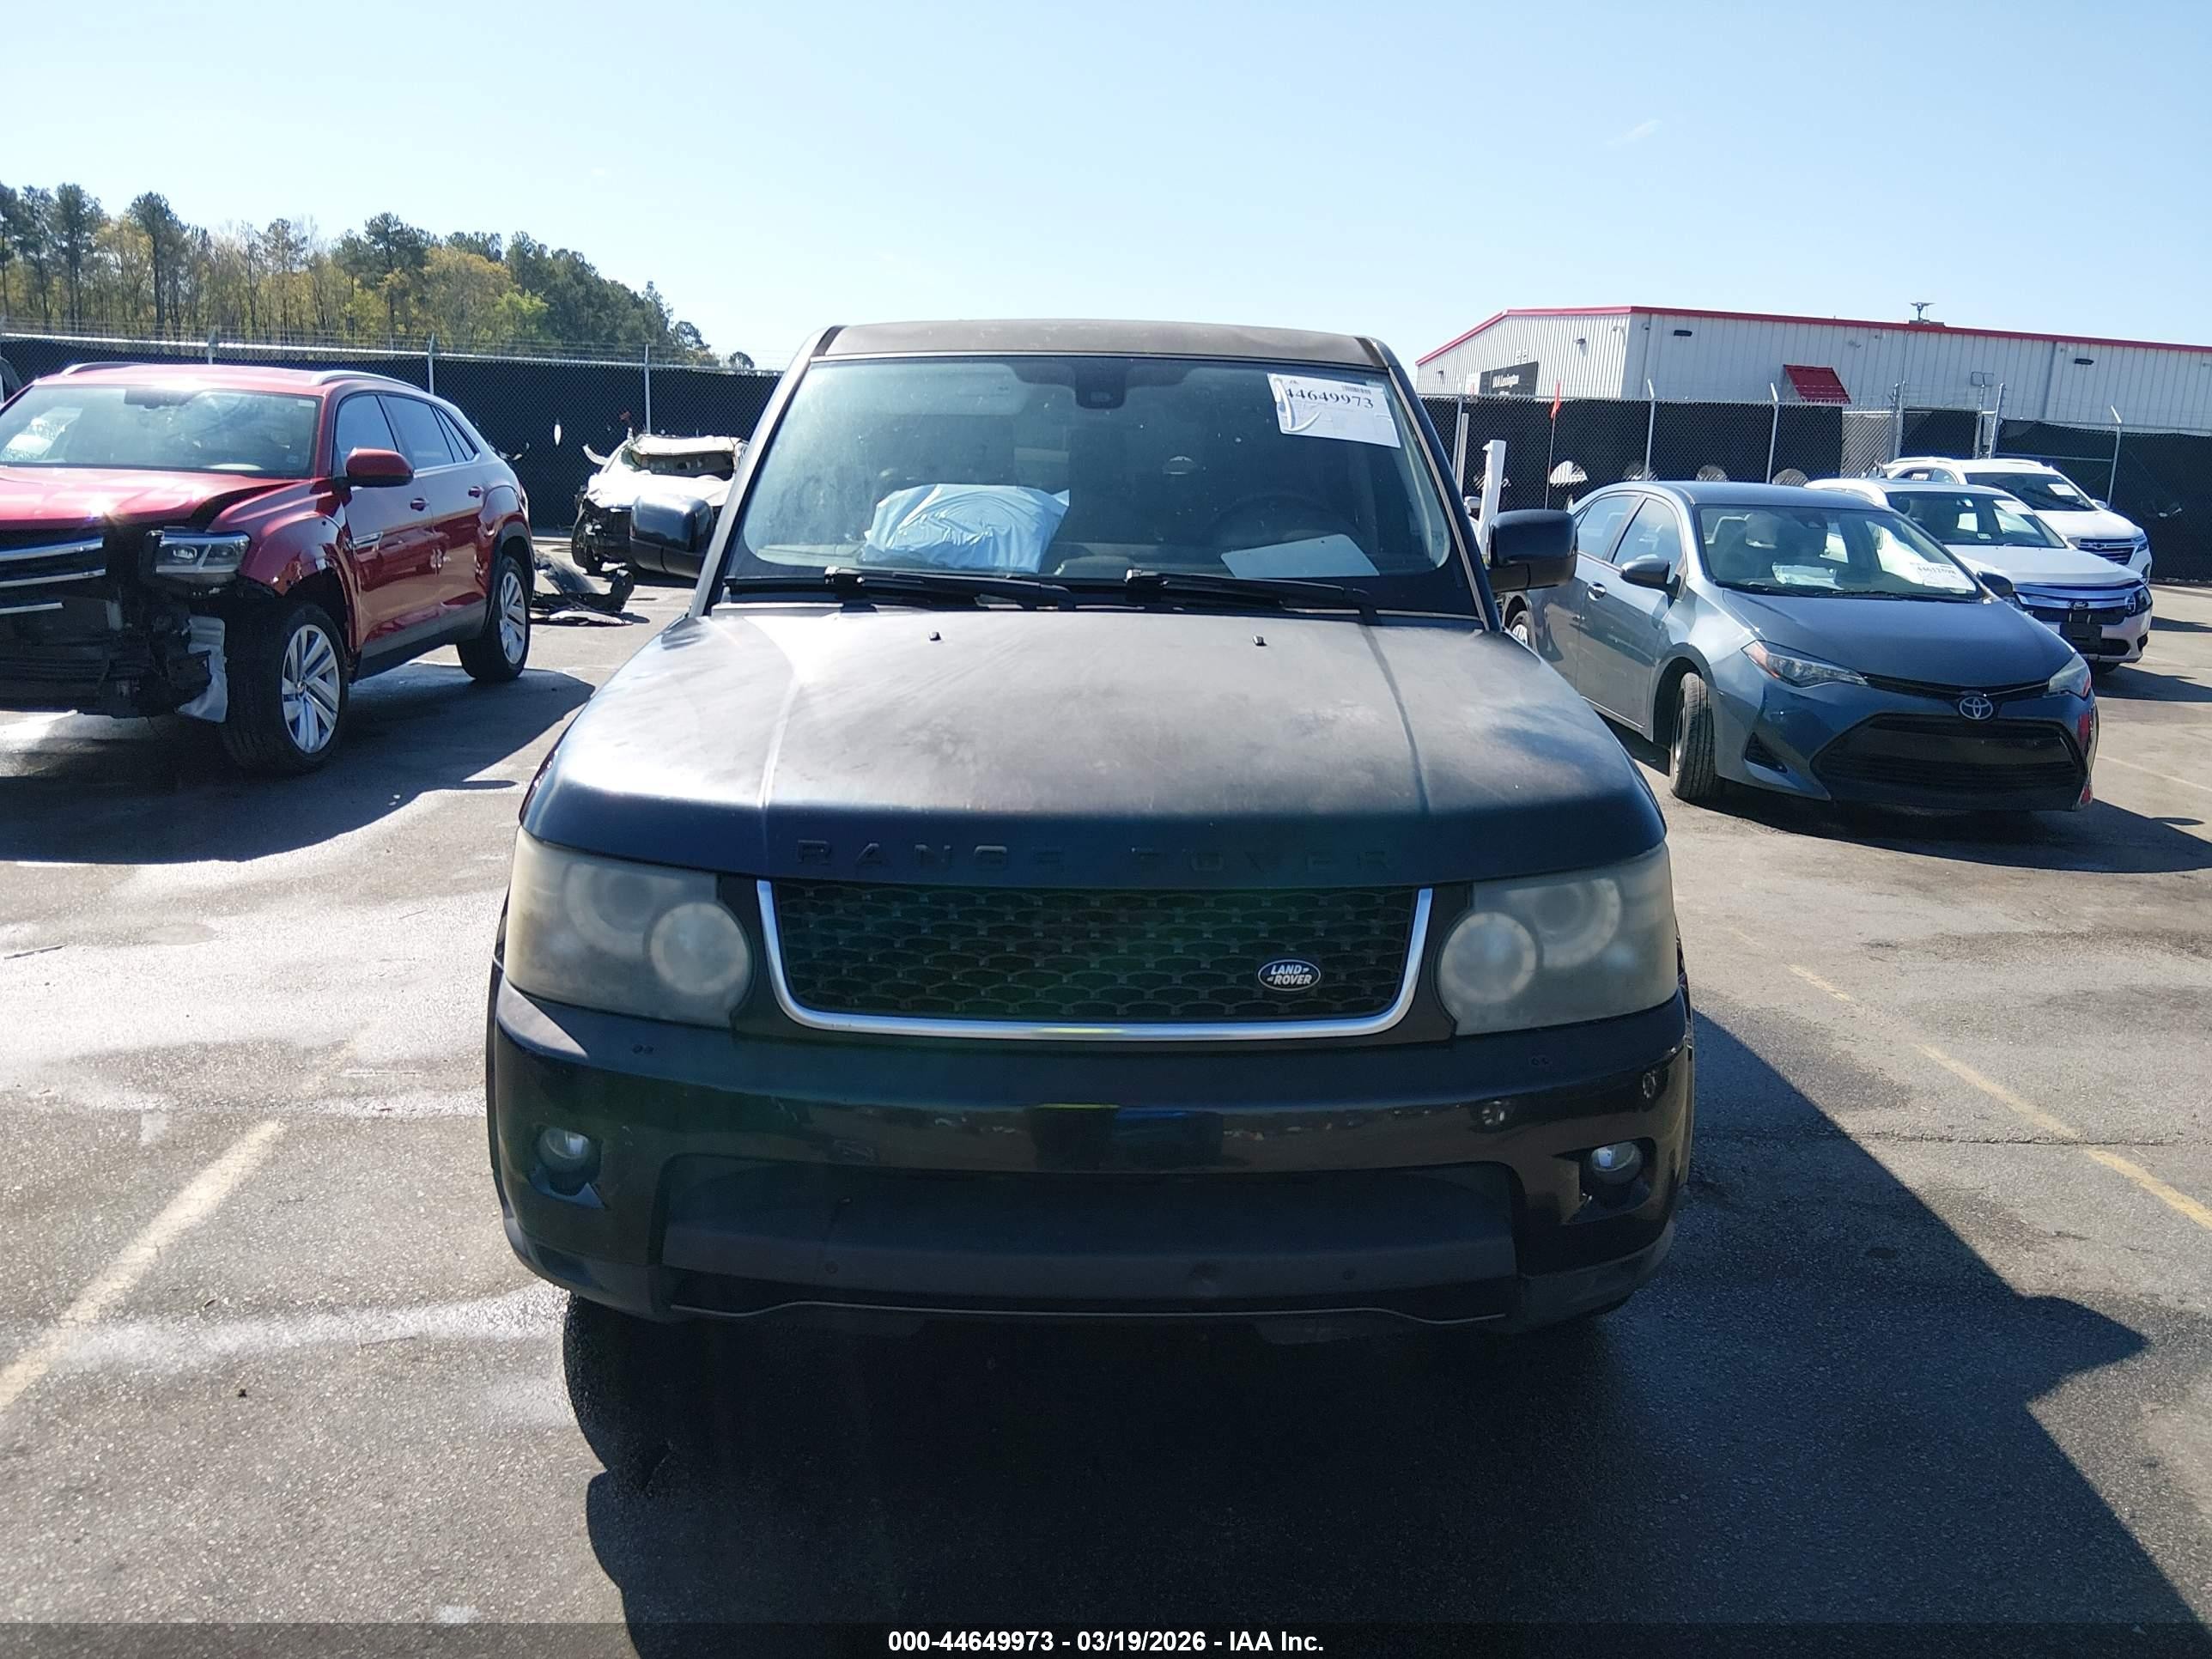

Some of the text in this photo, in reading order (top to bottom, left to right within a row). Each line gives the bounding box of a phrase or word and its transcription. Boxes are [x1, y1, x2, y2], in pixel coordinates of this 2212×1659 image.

[1286, 387, 1374, 410] 44649973
[1270, 964, 1303, 975] LAND
[1273, 974, 1312, 985] ROVER
